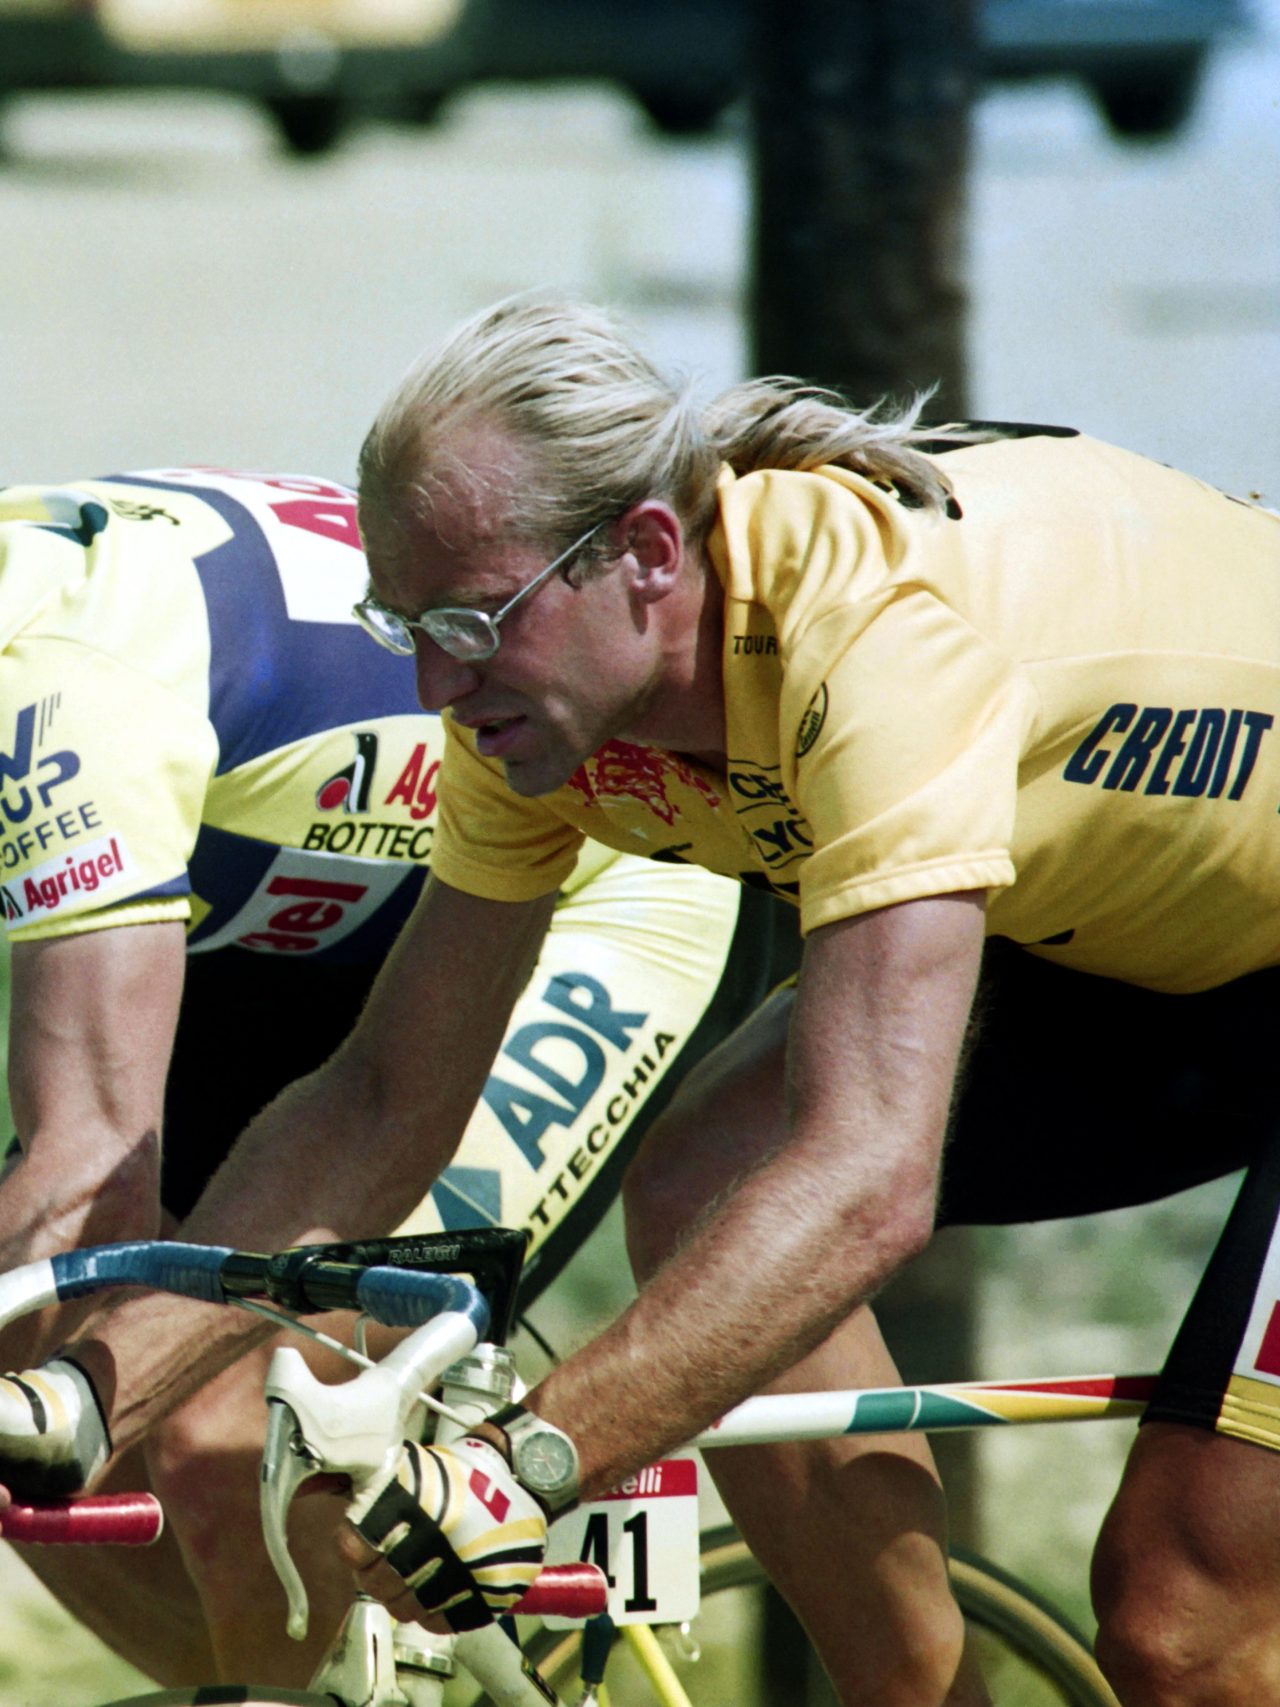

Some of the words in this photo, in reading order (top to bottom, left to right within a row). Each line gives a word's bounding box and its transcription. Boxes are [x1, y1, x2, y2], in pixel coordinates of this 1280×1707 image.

[1063, 703, 1274, 801] CREDIT
[23, 837, 124, 913] Agrigel
[481, 971, 650, 1173] ADR
[612, 1466, 663, 1495] elli
[580, 1511, 657, 1612] 41
